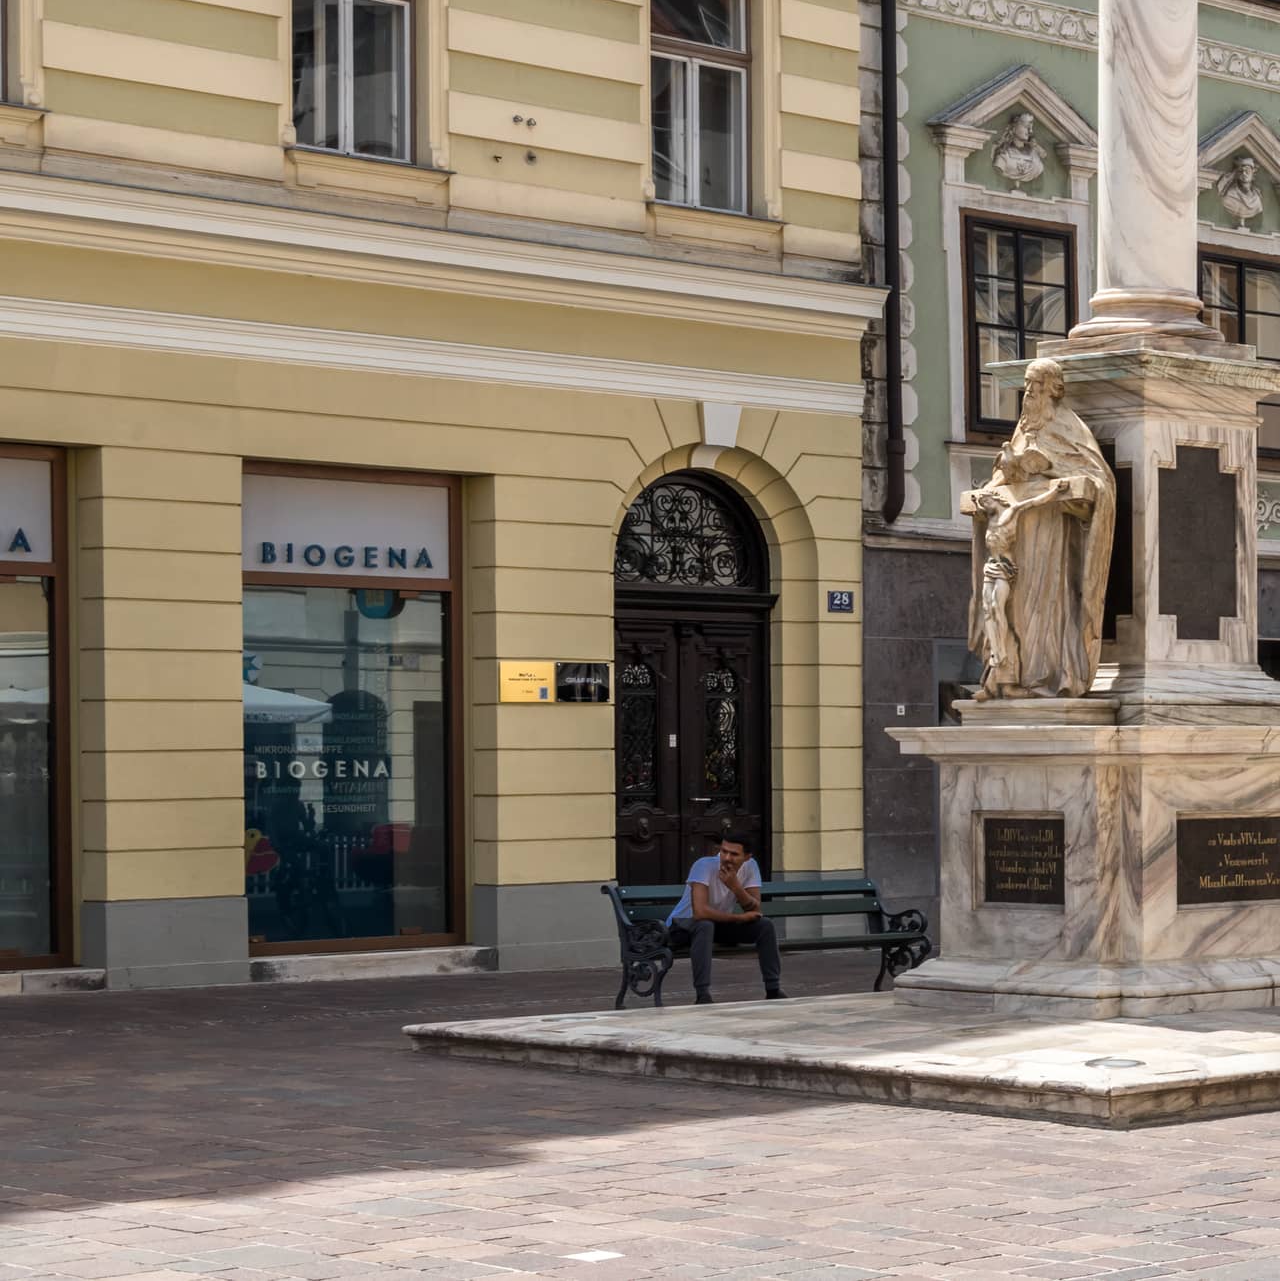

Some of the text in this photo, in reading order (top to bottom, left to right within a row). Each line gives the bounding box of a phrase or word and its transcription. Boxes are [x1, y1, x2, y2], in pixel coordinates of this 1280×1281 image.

[261, 541, 433, 570] BIOGENA
[833, 592, 849, 605] 28
[255, 759, 390, 779] BIOGENA
